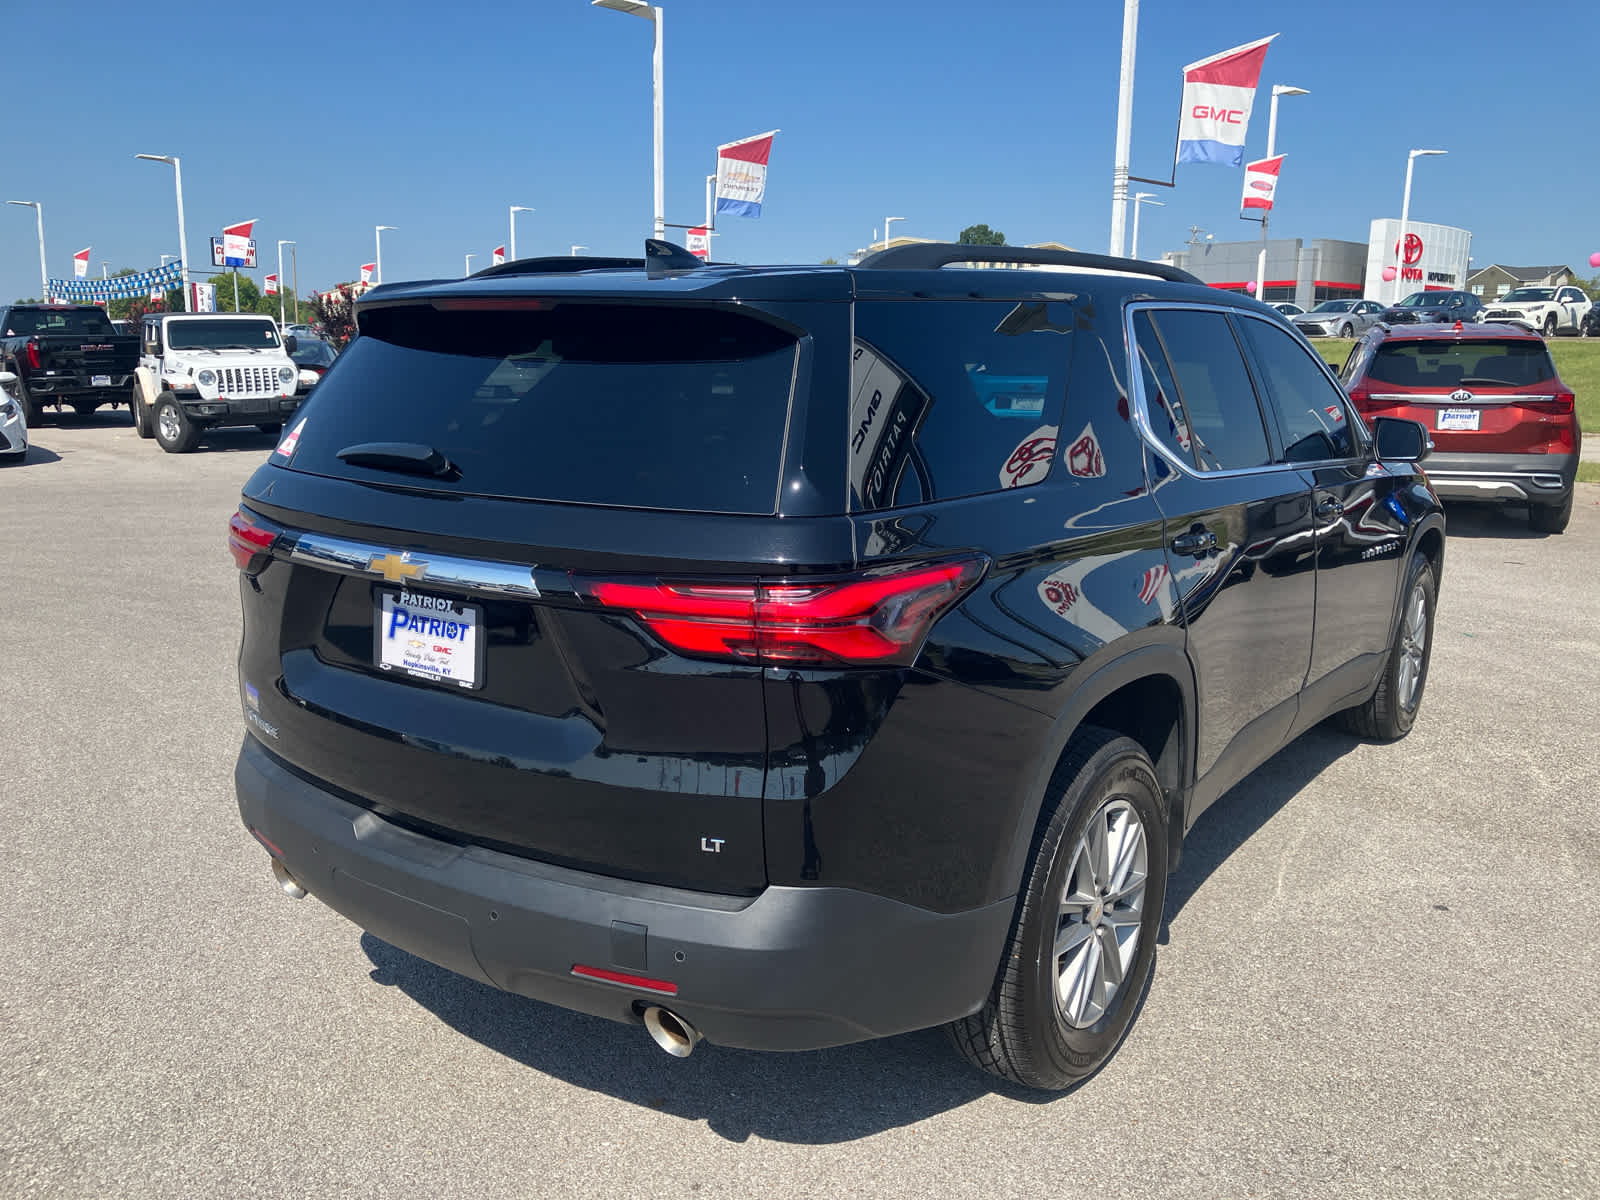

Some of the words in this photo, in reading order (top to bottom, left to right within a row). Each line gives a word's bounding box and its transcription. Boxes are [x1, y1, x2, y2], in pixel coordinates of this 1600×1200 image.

[1192, 105, 1243, 125] GMC
[1453, 392, 1471, 401] KIA
[1442, 413, 1477, 422] PATRIOT
[401, 591, 453, 612] PATRIOT
[388, 607, 470, 641] PATRIOT
[433, 645, 453, 655] GMC
[443, 667, 452, 675] KY
[701, 838, 726, 853] LT
